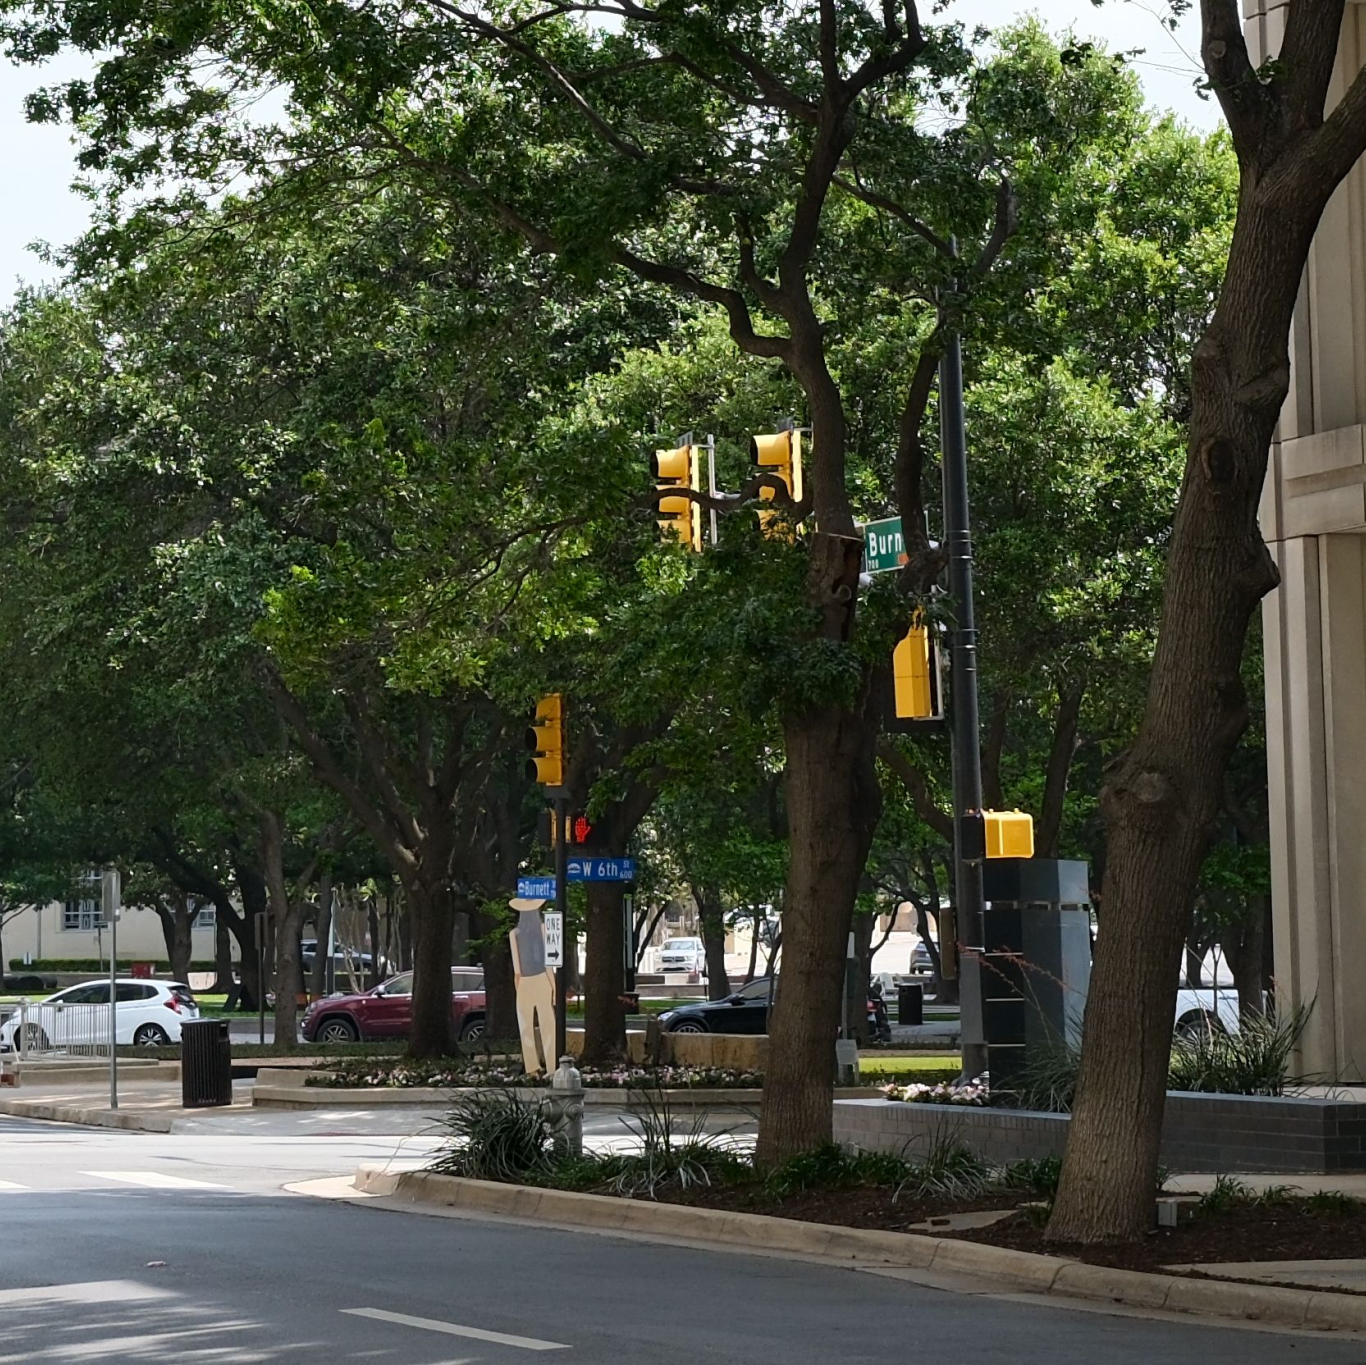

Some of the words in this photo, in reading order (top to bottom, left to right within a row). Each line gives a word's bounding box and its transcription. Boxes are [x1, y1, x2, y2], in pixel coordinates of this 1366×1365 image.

[868, 532, 903, 557] Burn
[582, 861, 592, 876] W
[598, 862, 618, 876] 6th
[620, 870, 633, 879] 600
[525, 881, 550, 896] Burnett
[546, 918, 560, 931] ONE
[546, 934, 560, 945] WAY
